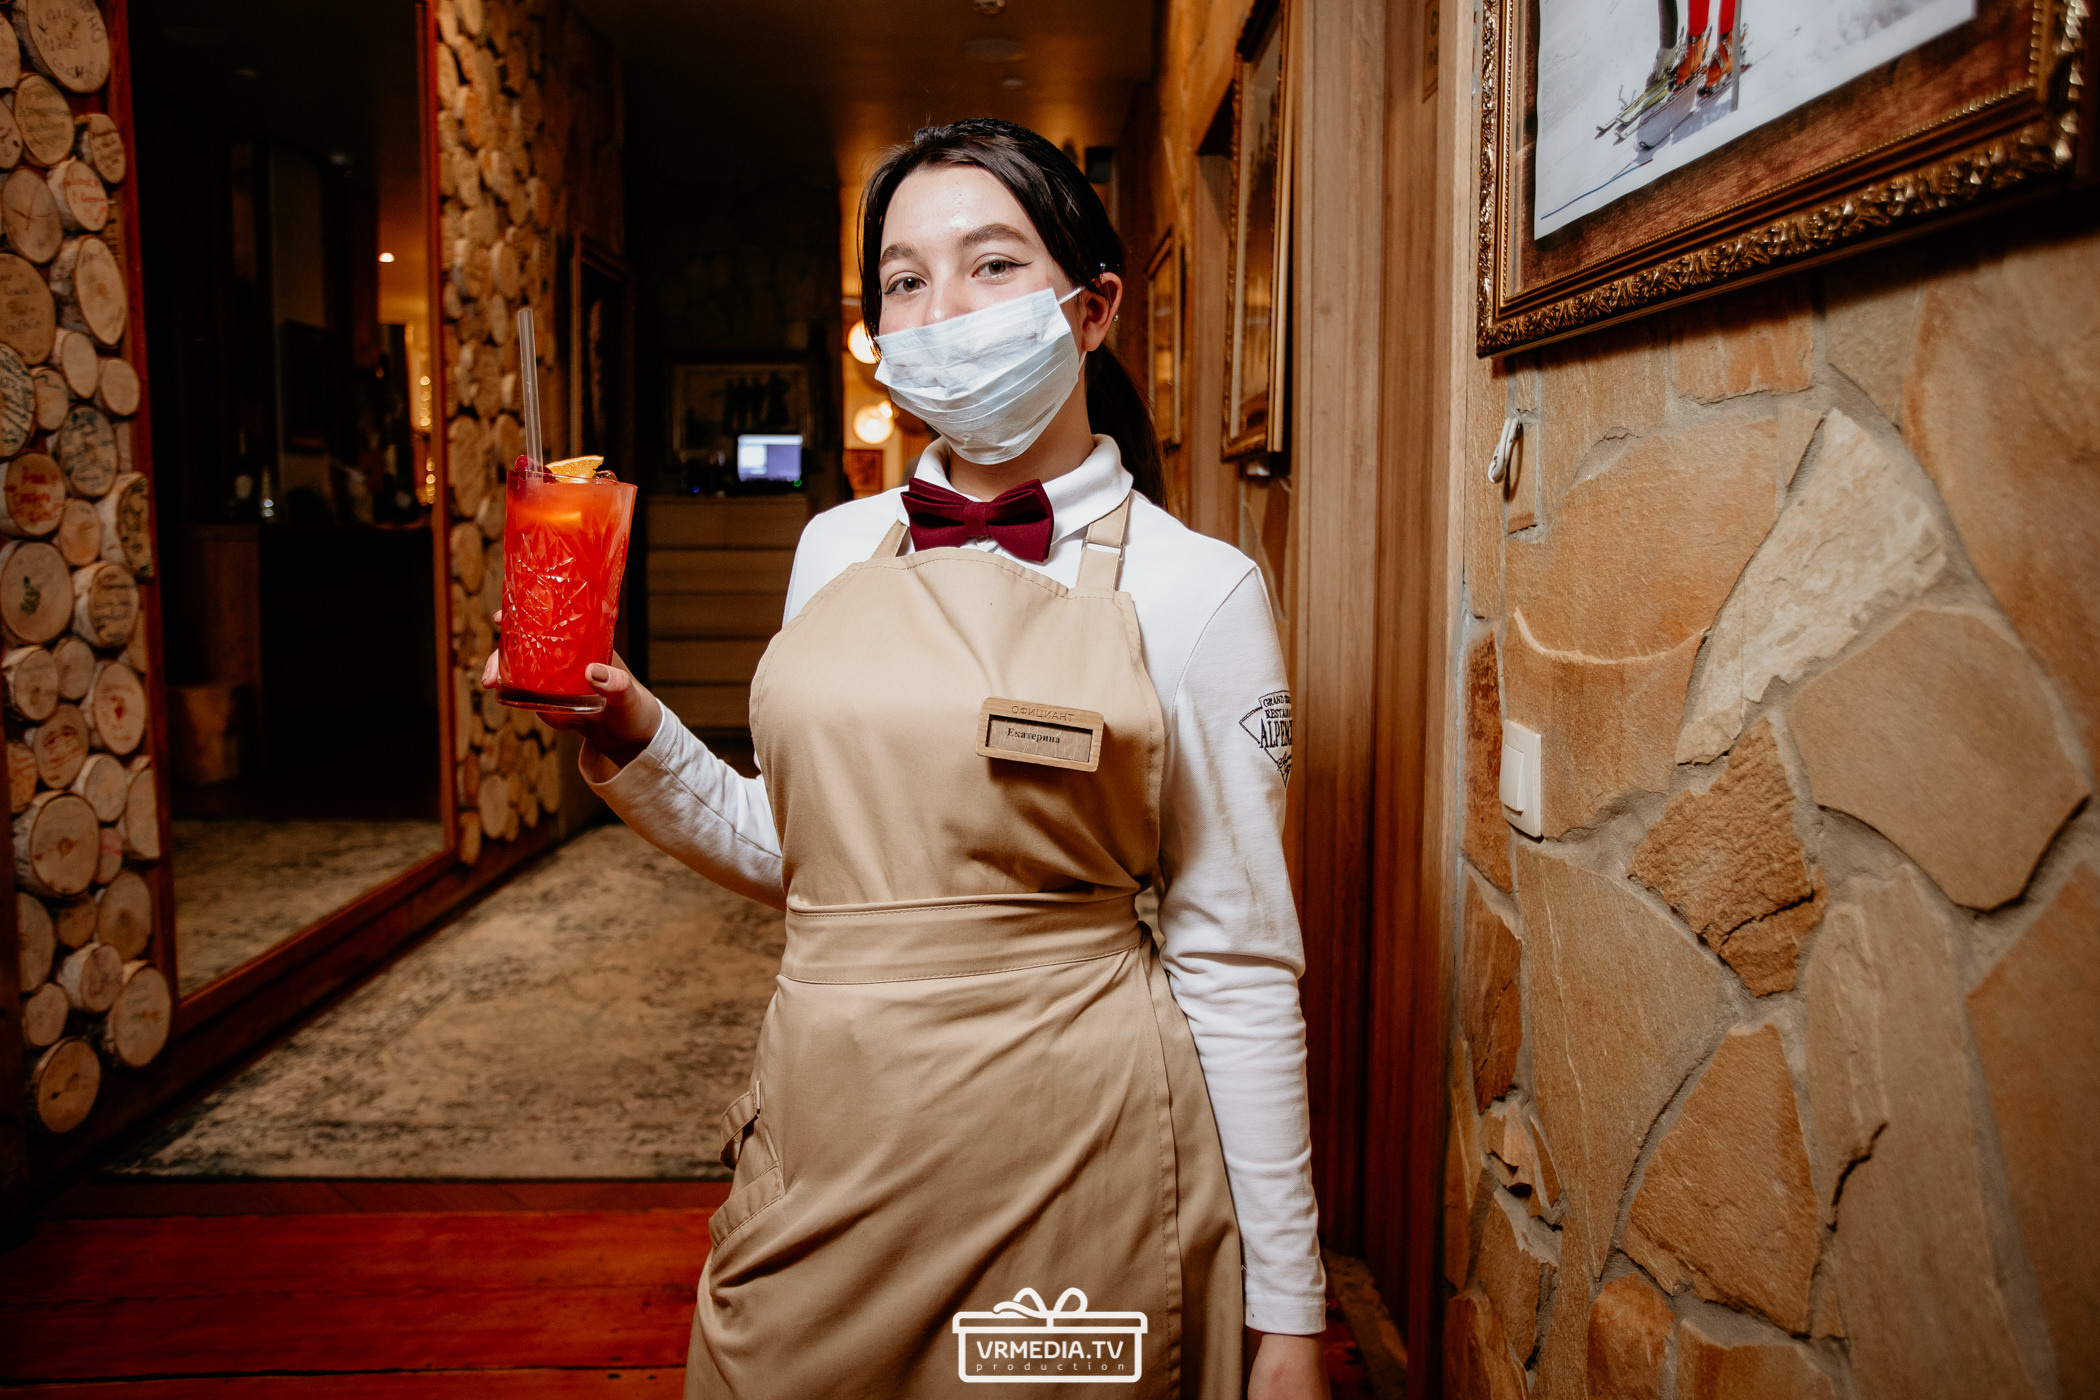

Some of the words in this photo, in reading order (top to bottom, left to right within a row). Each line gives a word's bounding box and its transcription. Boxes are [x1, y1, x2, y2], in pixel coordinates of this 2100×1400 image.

[1263, 694, 1284, 708] GRAND
[1011, 705, 1075, 722] ОФИЦИАНТ
[1007, 727, 1061, 744] Екатерина
